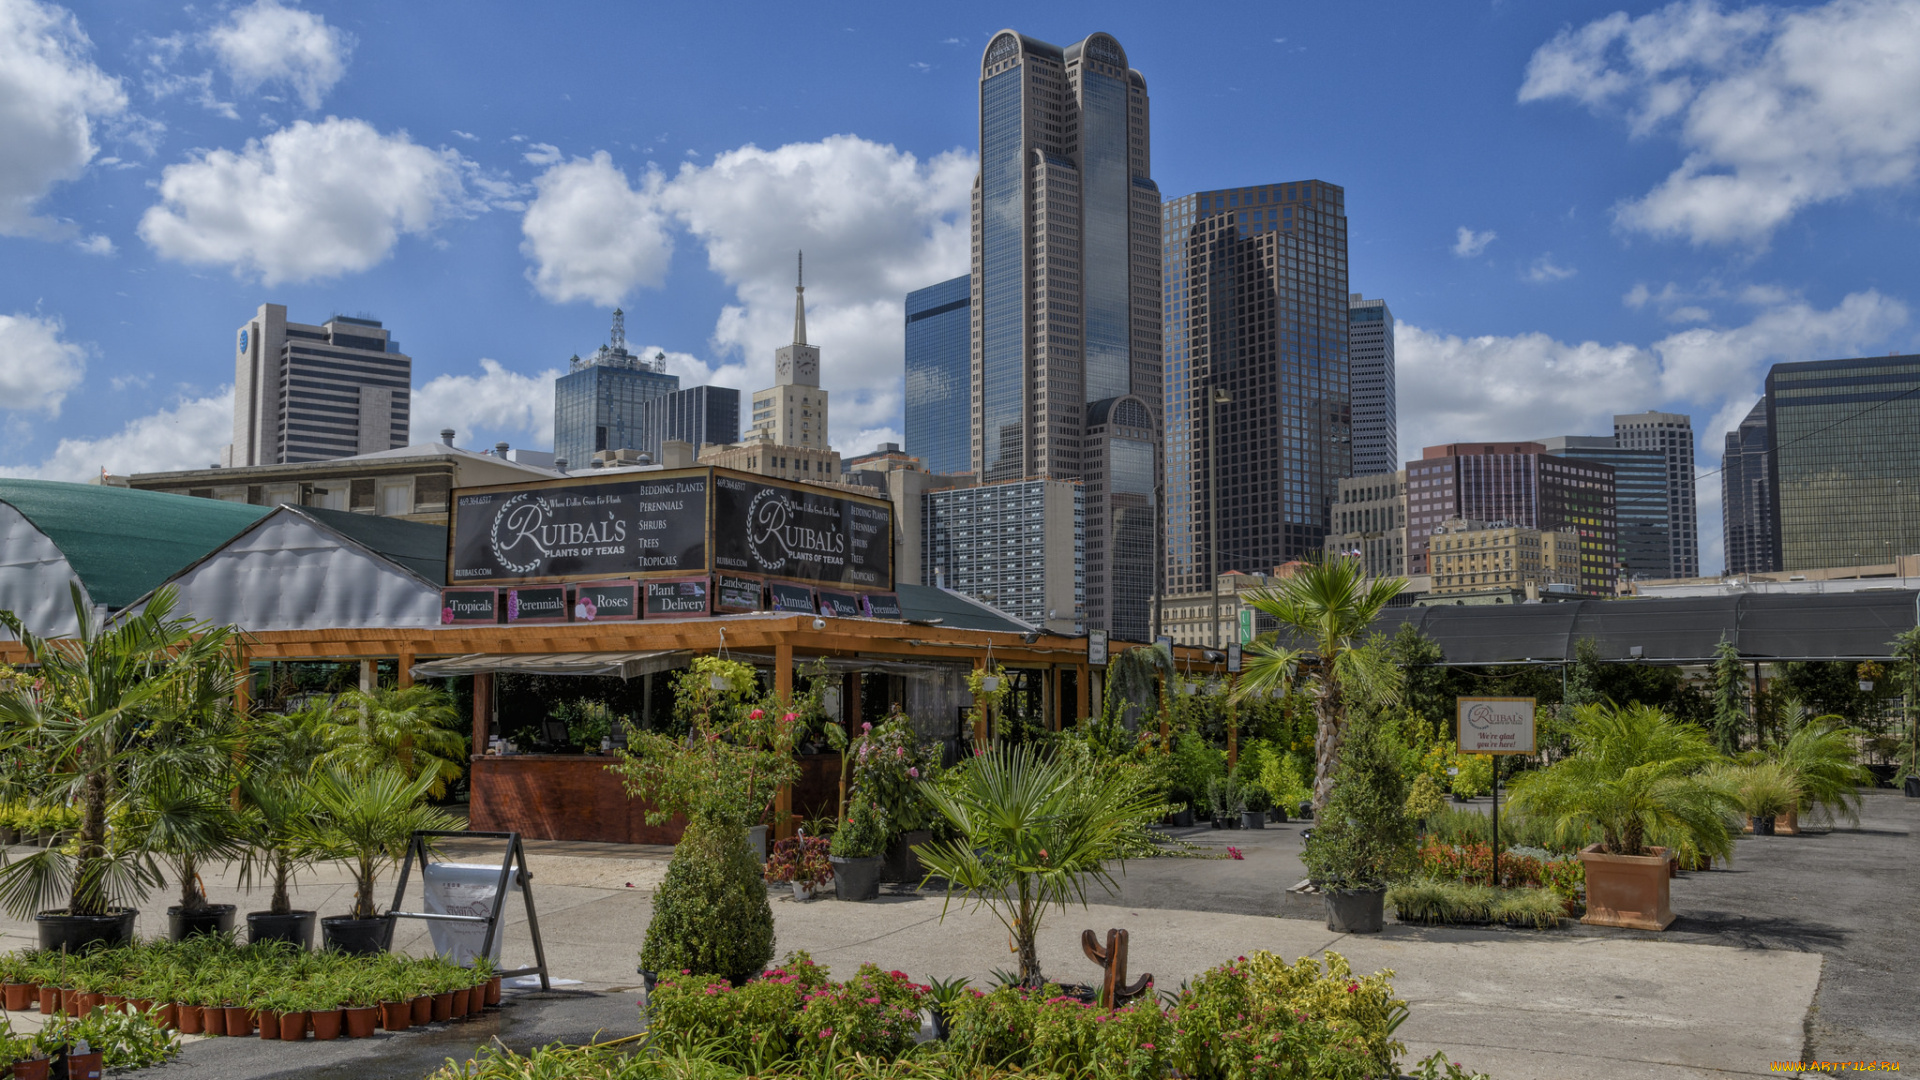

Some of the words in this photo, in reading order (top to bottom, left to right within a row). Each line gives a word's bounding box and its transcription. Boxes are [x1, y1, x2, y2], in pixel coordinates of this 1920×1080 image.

[640, 484, 674, 496] BEDDING
[676, 482, 704, 493] PLANTS
[550, 498, 565, 508] Where
[597, 495, 605, 505] For
[640, 501, 683, 512] PERENNIALS
[851, 505, 871, 518] BEDDING
[872, 510, 888, 521] PLANTS
[639, 520, 667, 531] SHRUBS
[851, 520, 877, 534] PERENNIALS
[638, 538, 659, 549] TREES
[851, 537, 868, 548] SHRUBS
[544, 549, 578, 558] PLANTS
[581, 548, 593, 556] OF
[596, 546, 625, 556] TEXAS
[788, 551, 813, 561] PLANTS
[814, 554, 822, 562] OF
[823, 556, 844, 565] TEXAS
[638, 556, 677, 567] TROPICALS
[717, 557, 747, 567] RUIBALS.COM
[851, 553, 863, 564] TREES
[455, 568, 492, 577] RUIBALS.COM
[851, 570, 874, 581] TROPICALS
[648, 583, 675, 596] Plant
[719, 576, 761, 593] Landscaping
[450, 599, 492, 613] Tropicals
[516, 597, 564, 612] Perennials
[597, 594, 628, 608] Roses
[662, 597, 706, 612] Delivery
[779, 593, 812, 610] Annuals
[833, 600, 855, 614] Roses
[870, 602, 900, 614] Perennials
[1499, 733, 1515, 741] glad
[1477, 741, 1498, 749] you're
